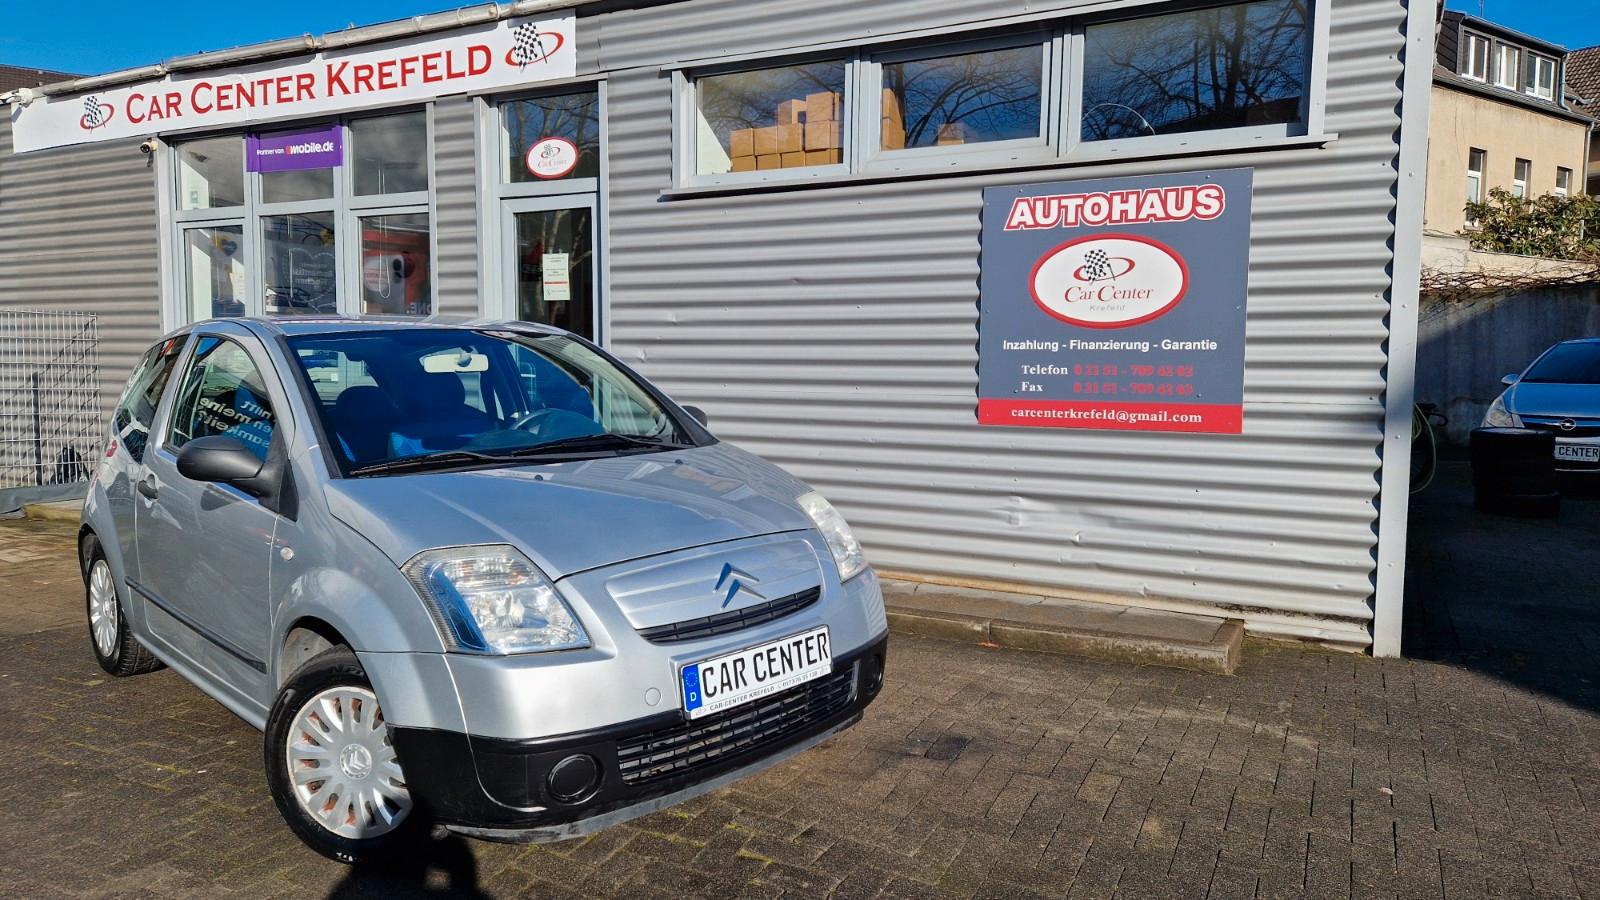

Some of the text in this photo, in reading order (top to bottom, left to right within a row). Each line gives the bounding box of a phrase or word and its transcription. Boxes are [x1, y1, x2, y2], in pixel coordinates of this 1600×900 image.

[126, 44, 492, 124] CAR CENTER KREFELD
[1004, 184, 1225, 231] AUTOHAUS
[1064, 285, 1154, 303] Car Center
[1003, 339, 1059, 352] Inzahlung
[1069, 339, 1150, 352] Finanzierung
[1161, 339, 1218, 350] Garantie
[1021, 364, 1069, 375] Telefon
[1021, 381, 1044, 392] Fax
[1011, 408, 1203, 423] carcenterkrefeld@gmail.com
[1558, 446, 1599, 457] CENTER
[702, 632, 829, 698] CAR CENTER
[690, 692, 697, 702] D
